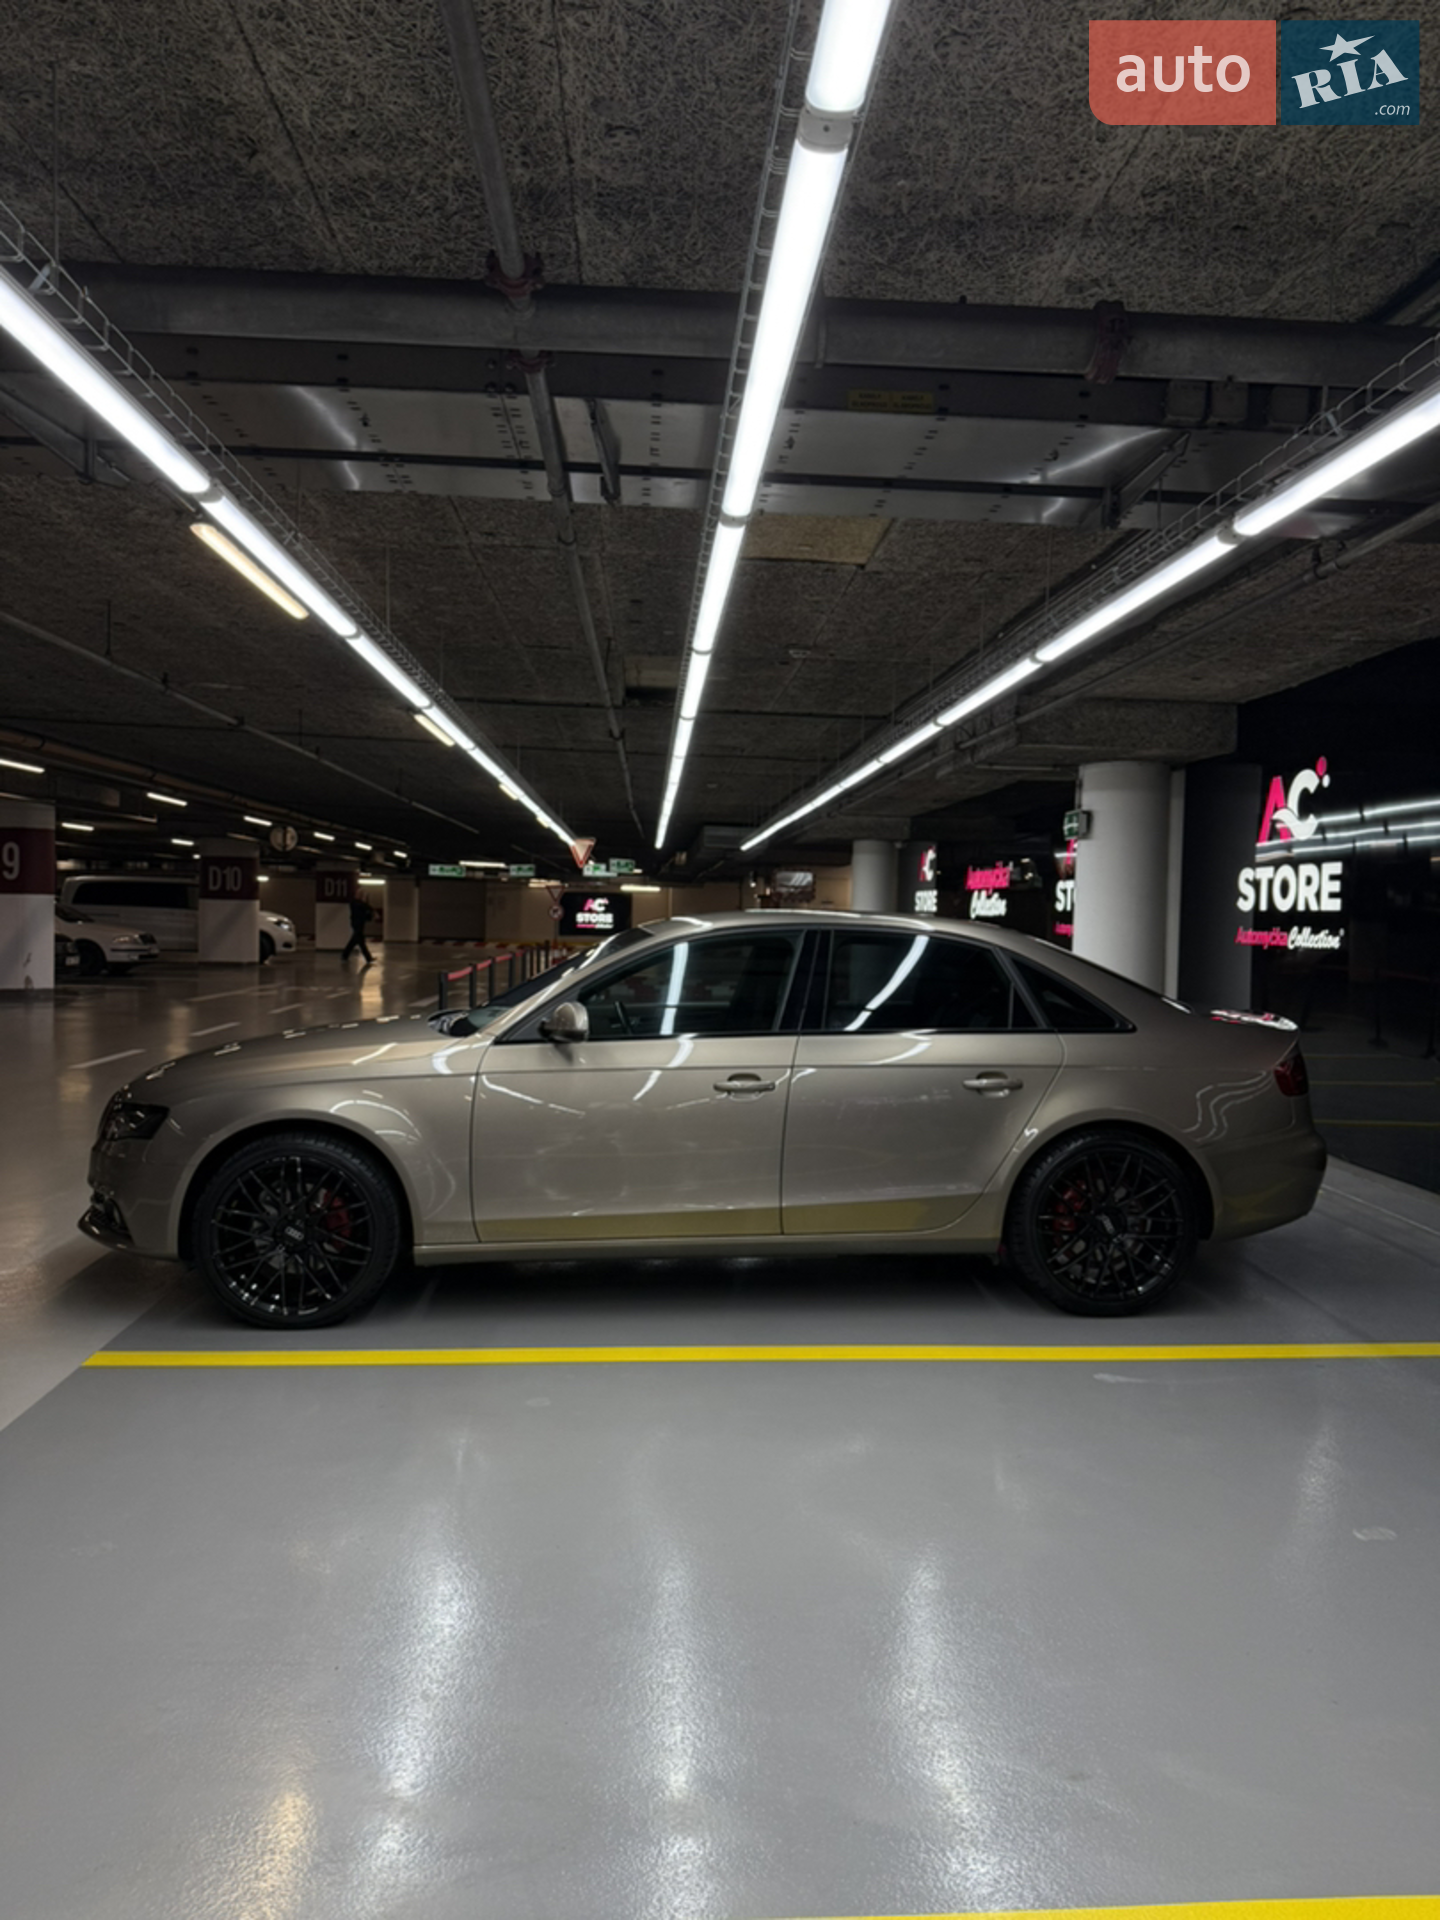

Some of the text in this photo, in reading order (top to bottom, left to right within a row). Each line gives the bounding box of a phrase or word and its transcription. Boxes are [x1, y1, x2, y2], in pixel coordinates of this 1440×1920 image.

[208, 866, 242, 891] D10
[324, 878, 348, 896] D11
[1236, 862, 1343, 912] STORE
[914, 889, 938, 912] STORE
[576, 913, 613, 923] STORE
